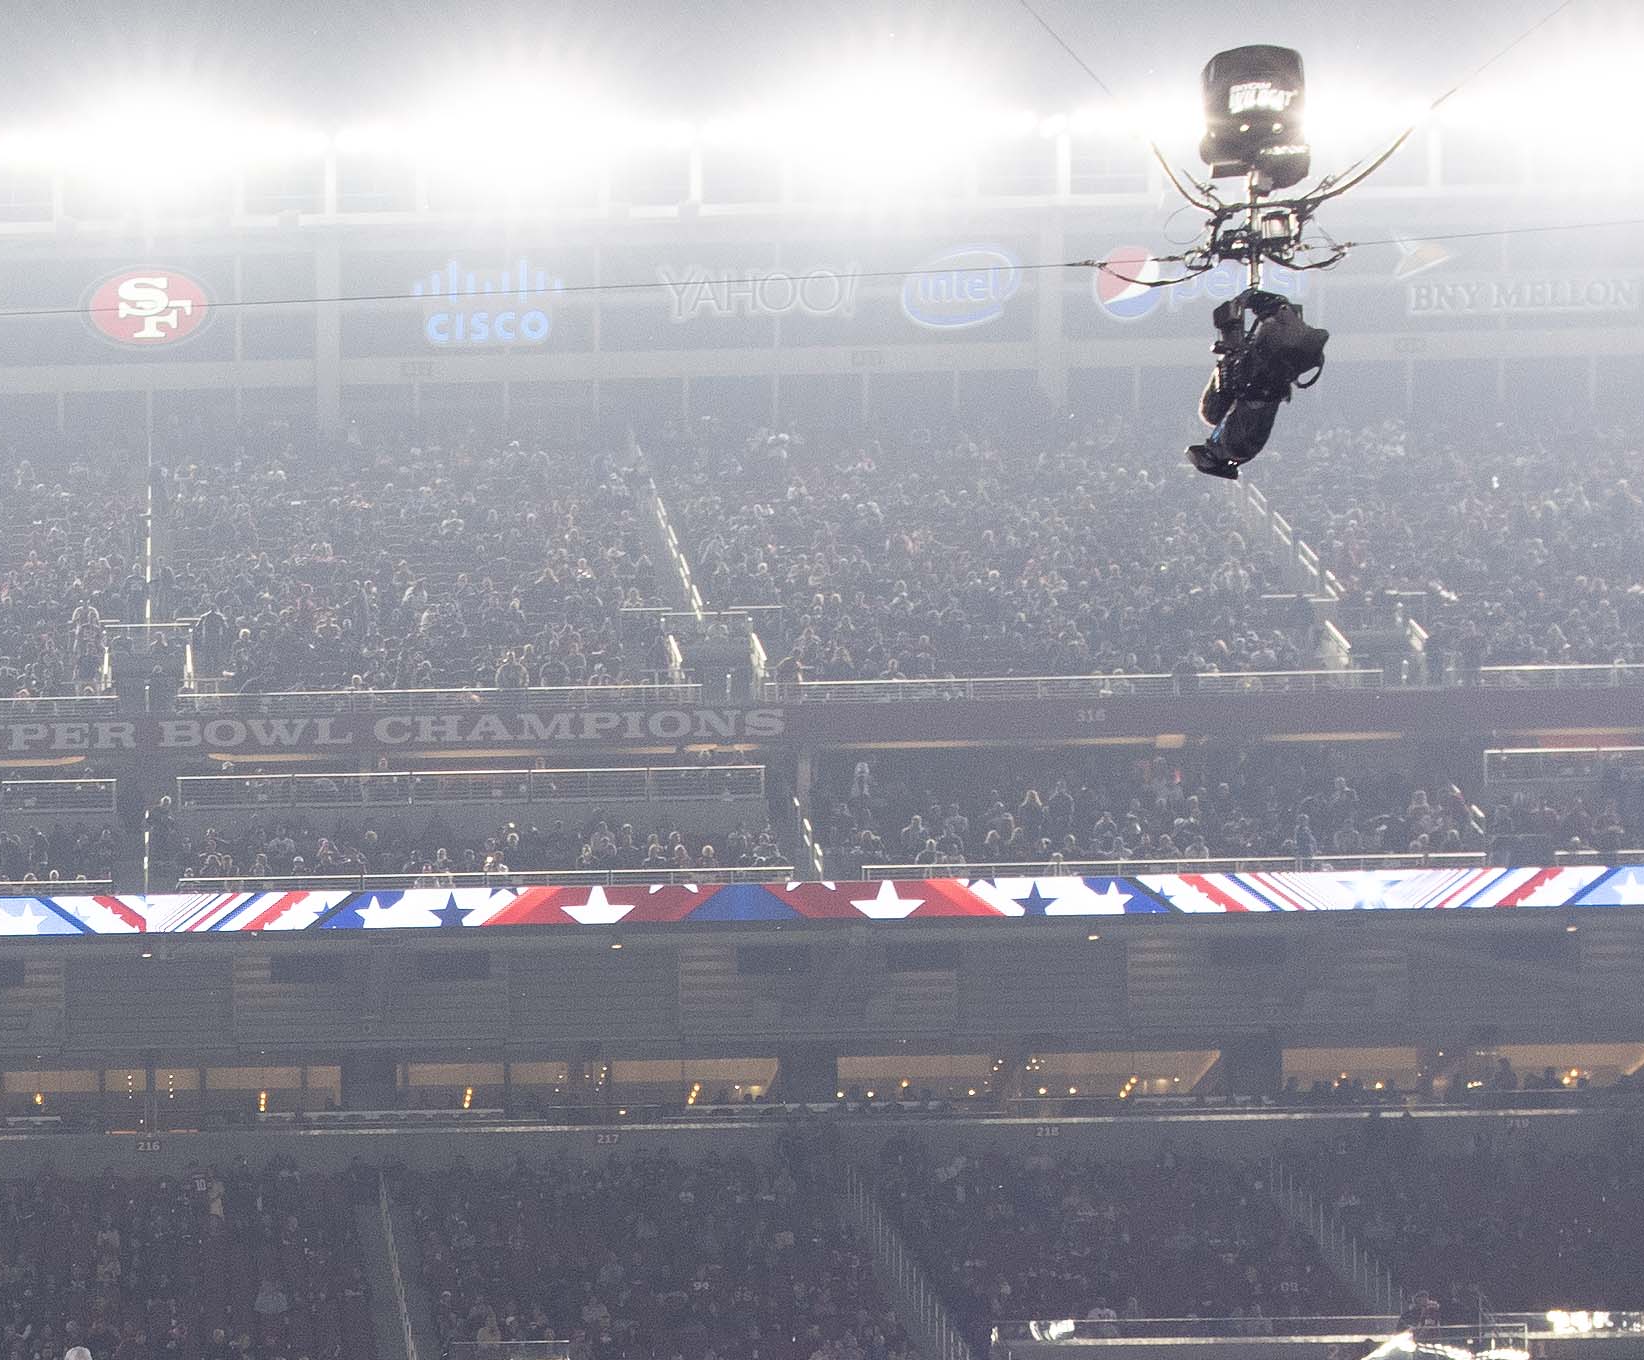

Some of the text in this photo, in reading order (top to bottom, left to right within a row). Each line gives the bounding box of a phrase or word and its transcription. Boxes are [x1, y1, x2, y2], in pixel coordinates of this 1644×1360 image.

[661, 267, 858, 319] YAHOO!
[919, 264, 998, 302] intel
[1412, 280, 1636, 315] BNY MELLON
[117, 277, 194, 338] SF
[160, 717, 354, 750] BOWL
[373, 707, 787, 747] CHAMPIONS
[138, 1142, 160, 1151] 216
[598, 1134, 619, 1144] 217
